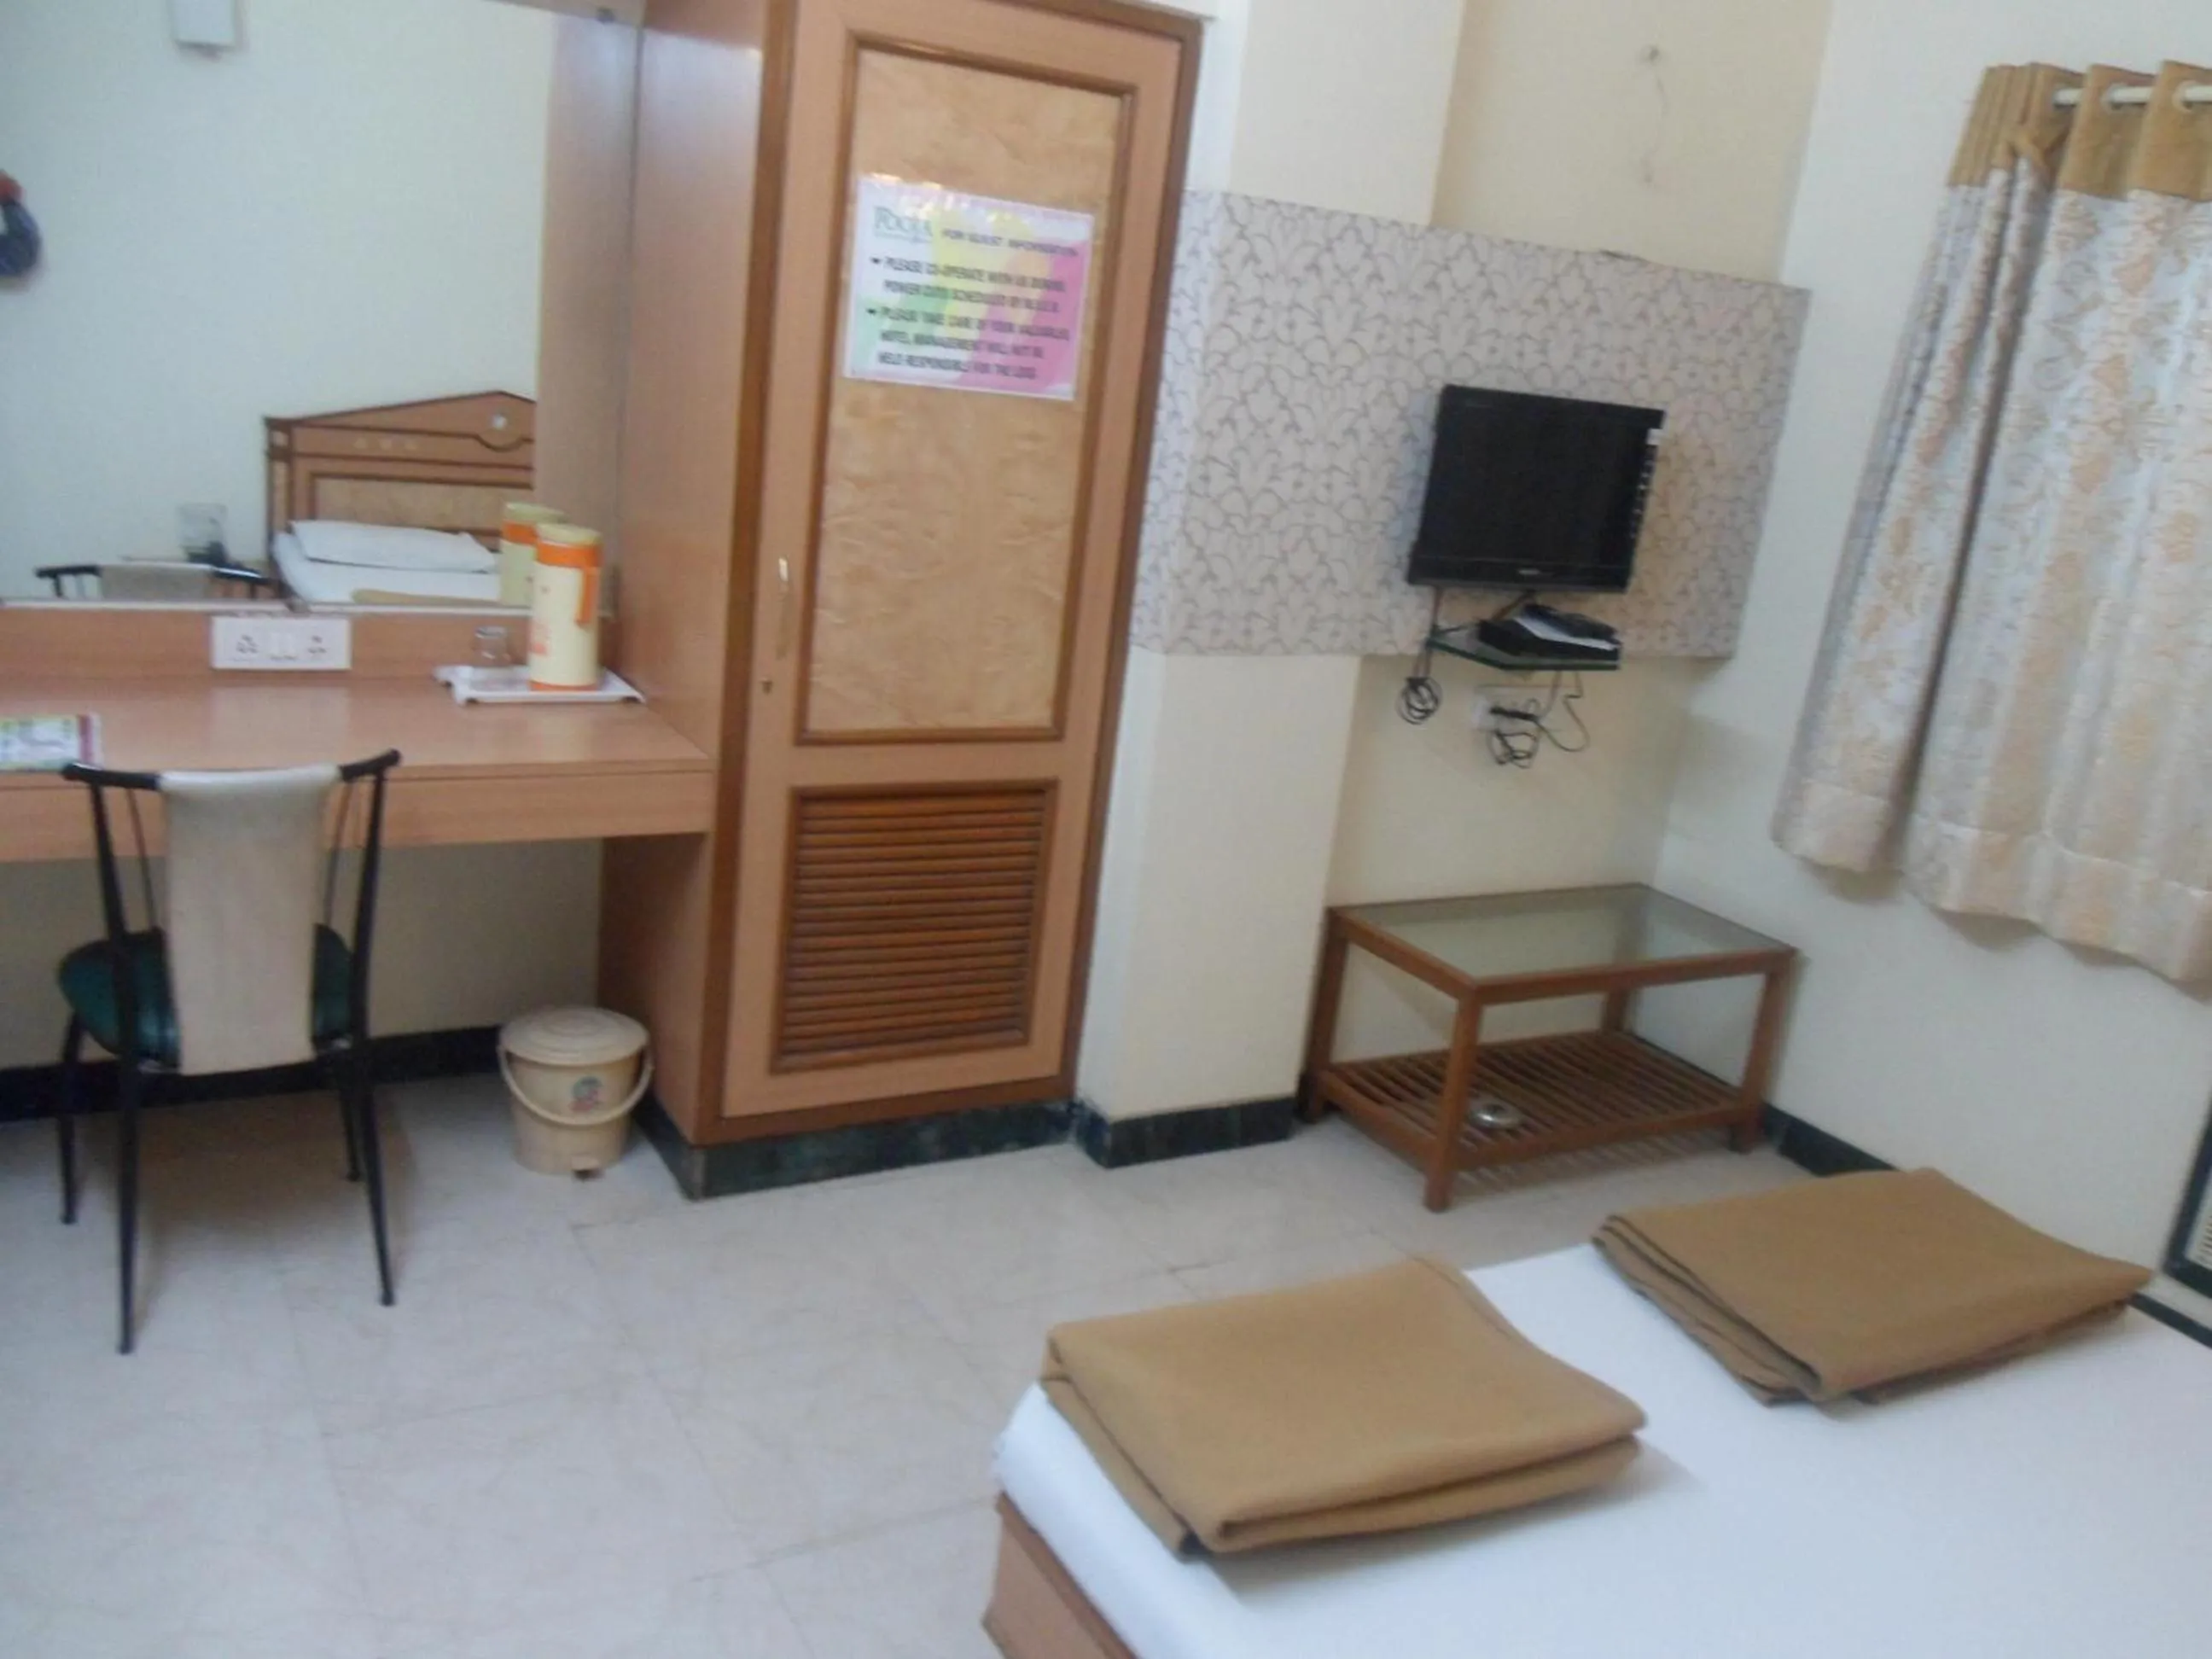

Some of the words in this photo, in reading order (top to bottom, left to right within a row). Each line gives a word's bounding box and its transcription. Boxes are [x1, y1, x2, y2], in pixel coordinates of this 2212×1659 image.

[885, 257, 923, 274] PLEASE
[926, 262, 986, 282] CO-OPERATE
[884, 280, 920, 295] POWER
[882, 306, 918, 323] PLEASE
